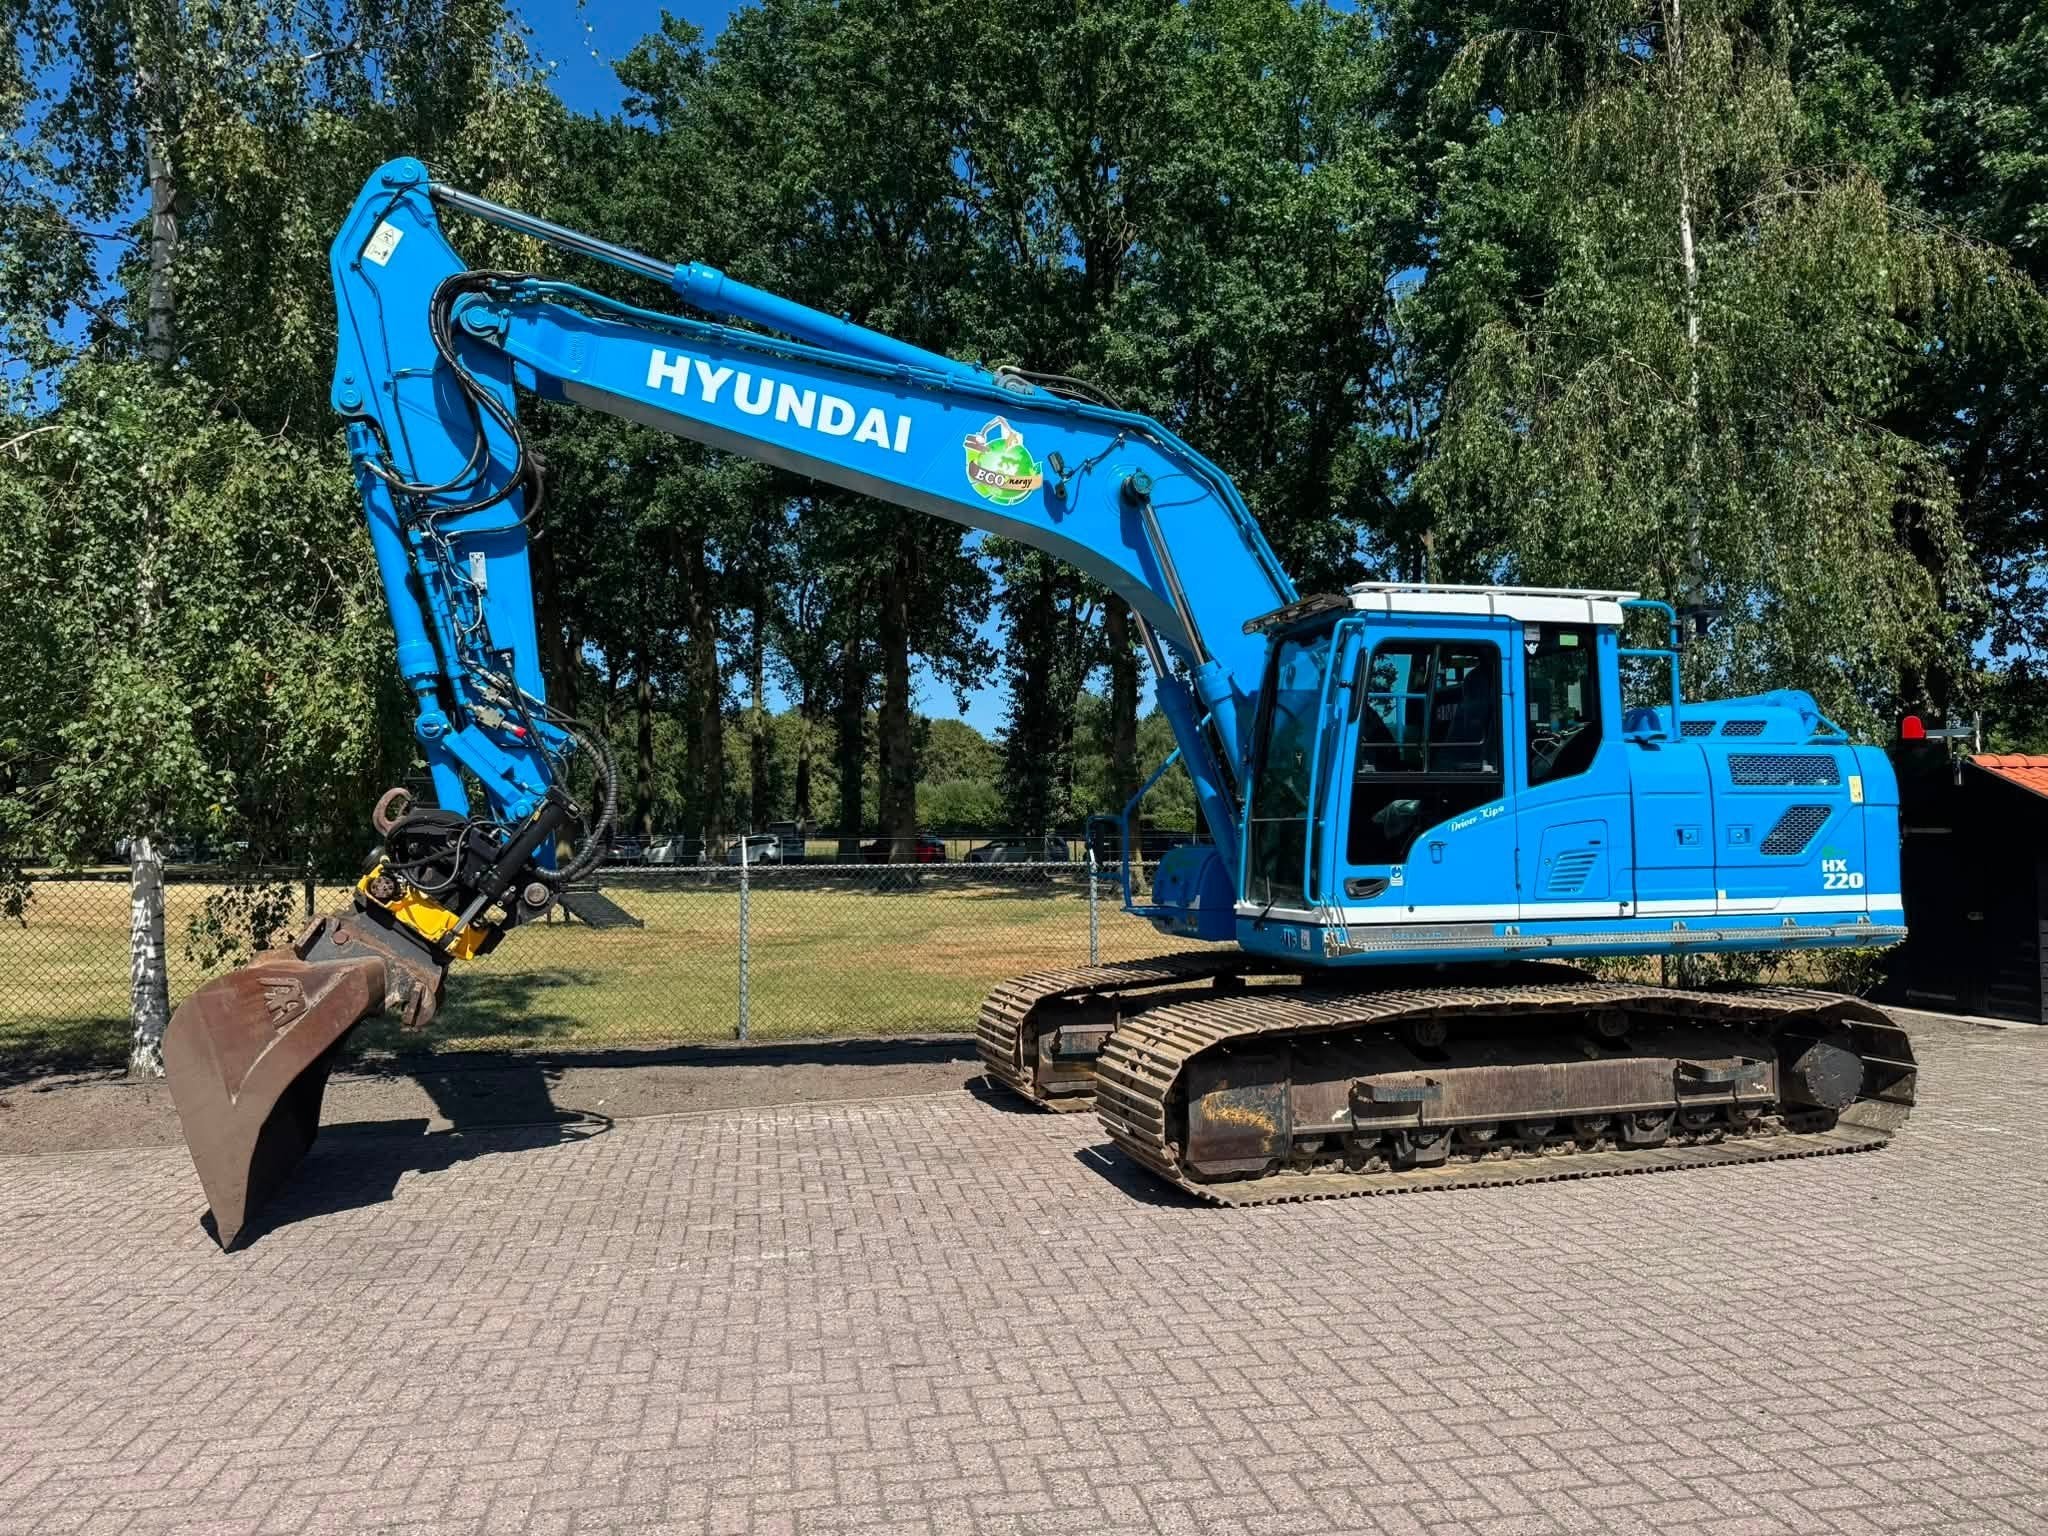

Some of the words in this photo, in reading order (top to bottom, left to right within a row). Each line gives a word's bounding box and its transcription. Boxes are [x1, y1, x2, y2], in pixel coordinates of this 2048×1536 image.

[646, 349, 912, 454] HYUNDAI
[975, 470, 1005, 487] ECO
[1821, 859, 1847, 872] HX
[1823, 872, 1864, 890] 220
